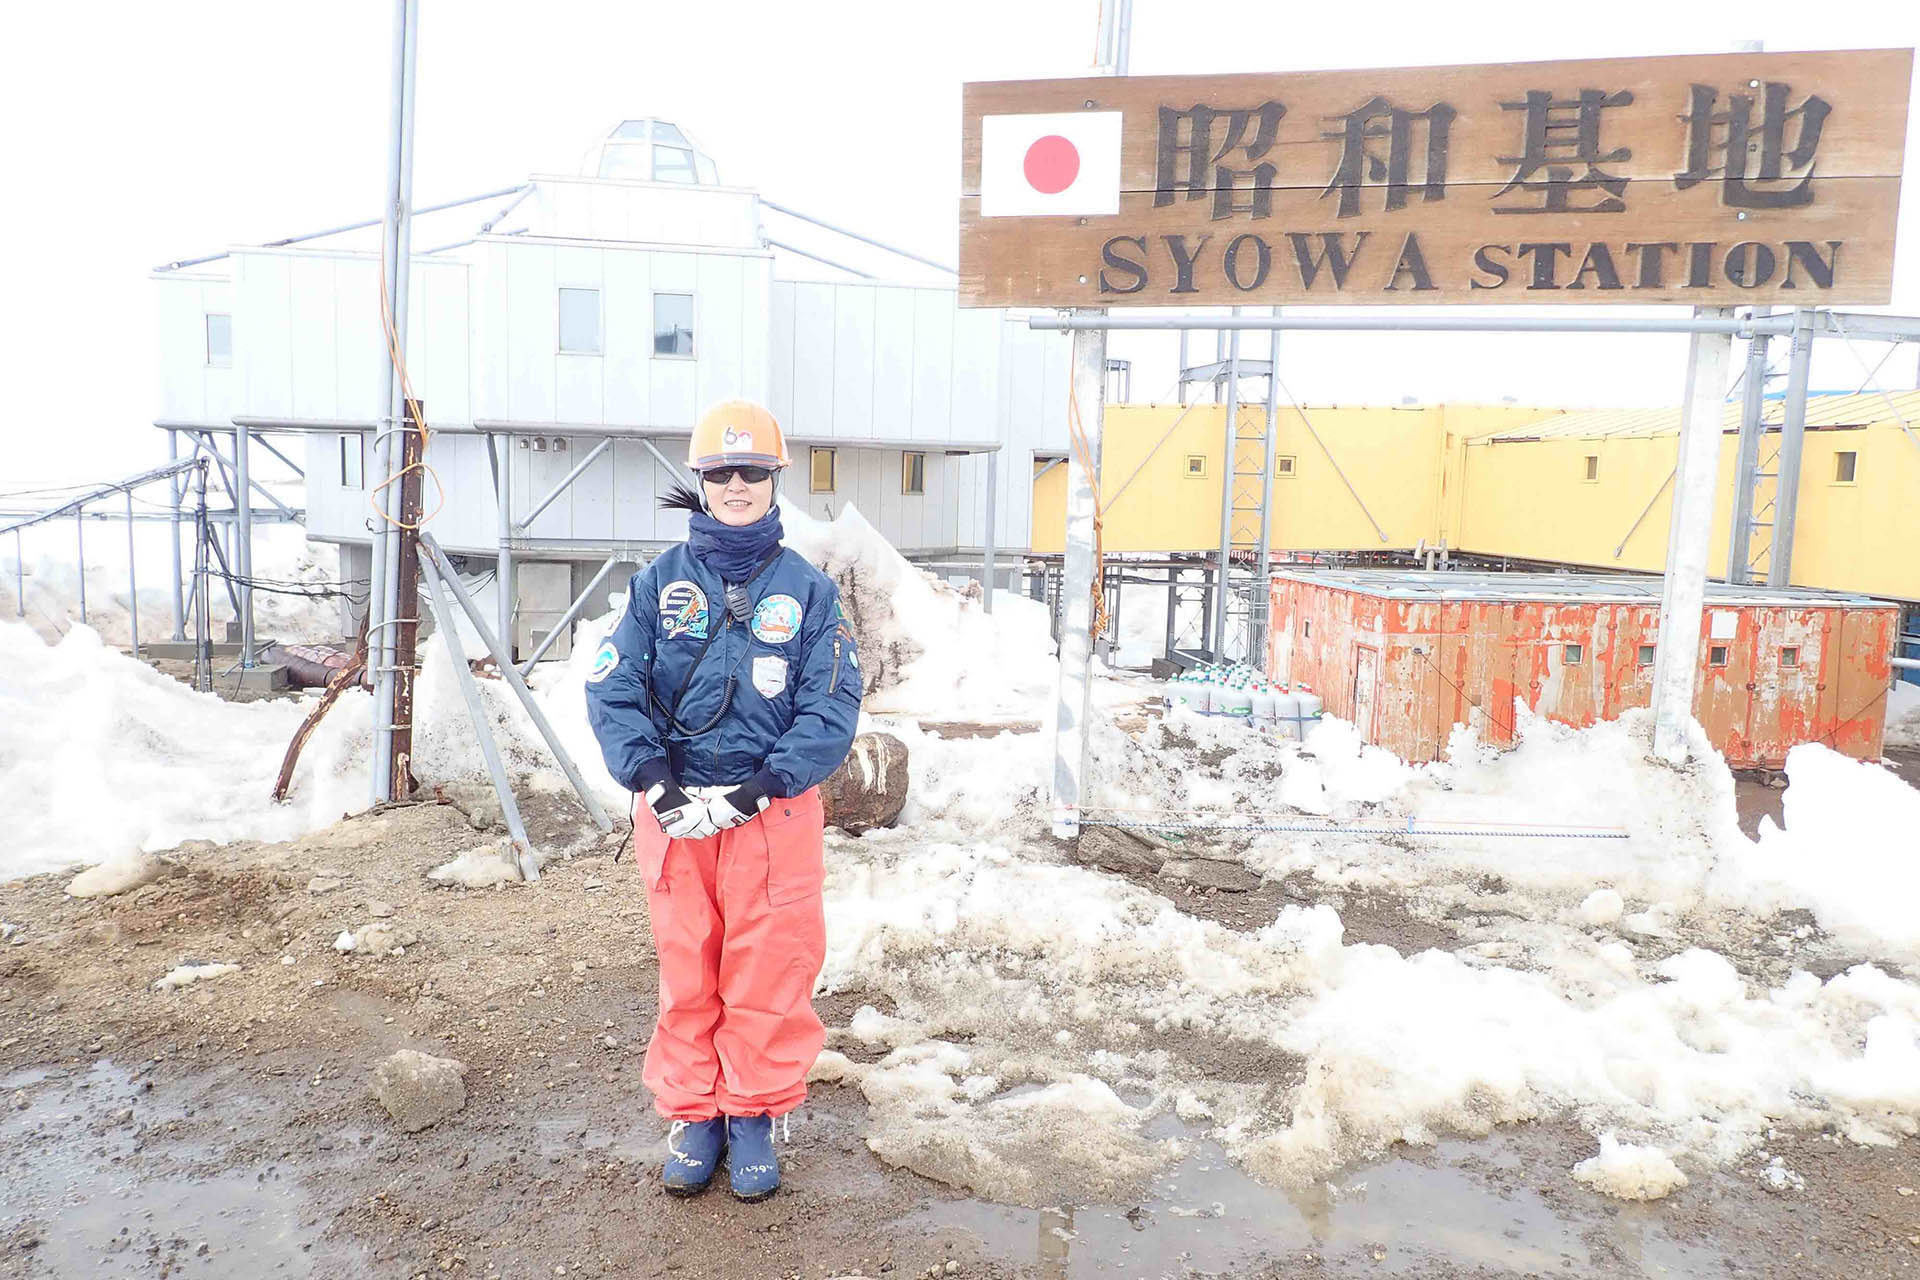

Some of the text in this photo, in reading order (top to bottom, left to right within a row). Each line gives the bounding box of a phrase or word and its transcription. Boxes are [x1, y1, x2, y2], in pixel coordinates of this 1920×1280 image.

[1152, 81, 1832, 221] 昭和基地
[1098, 231, 1843, 294] SYOWA STATION
